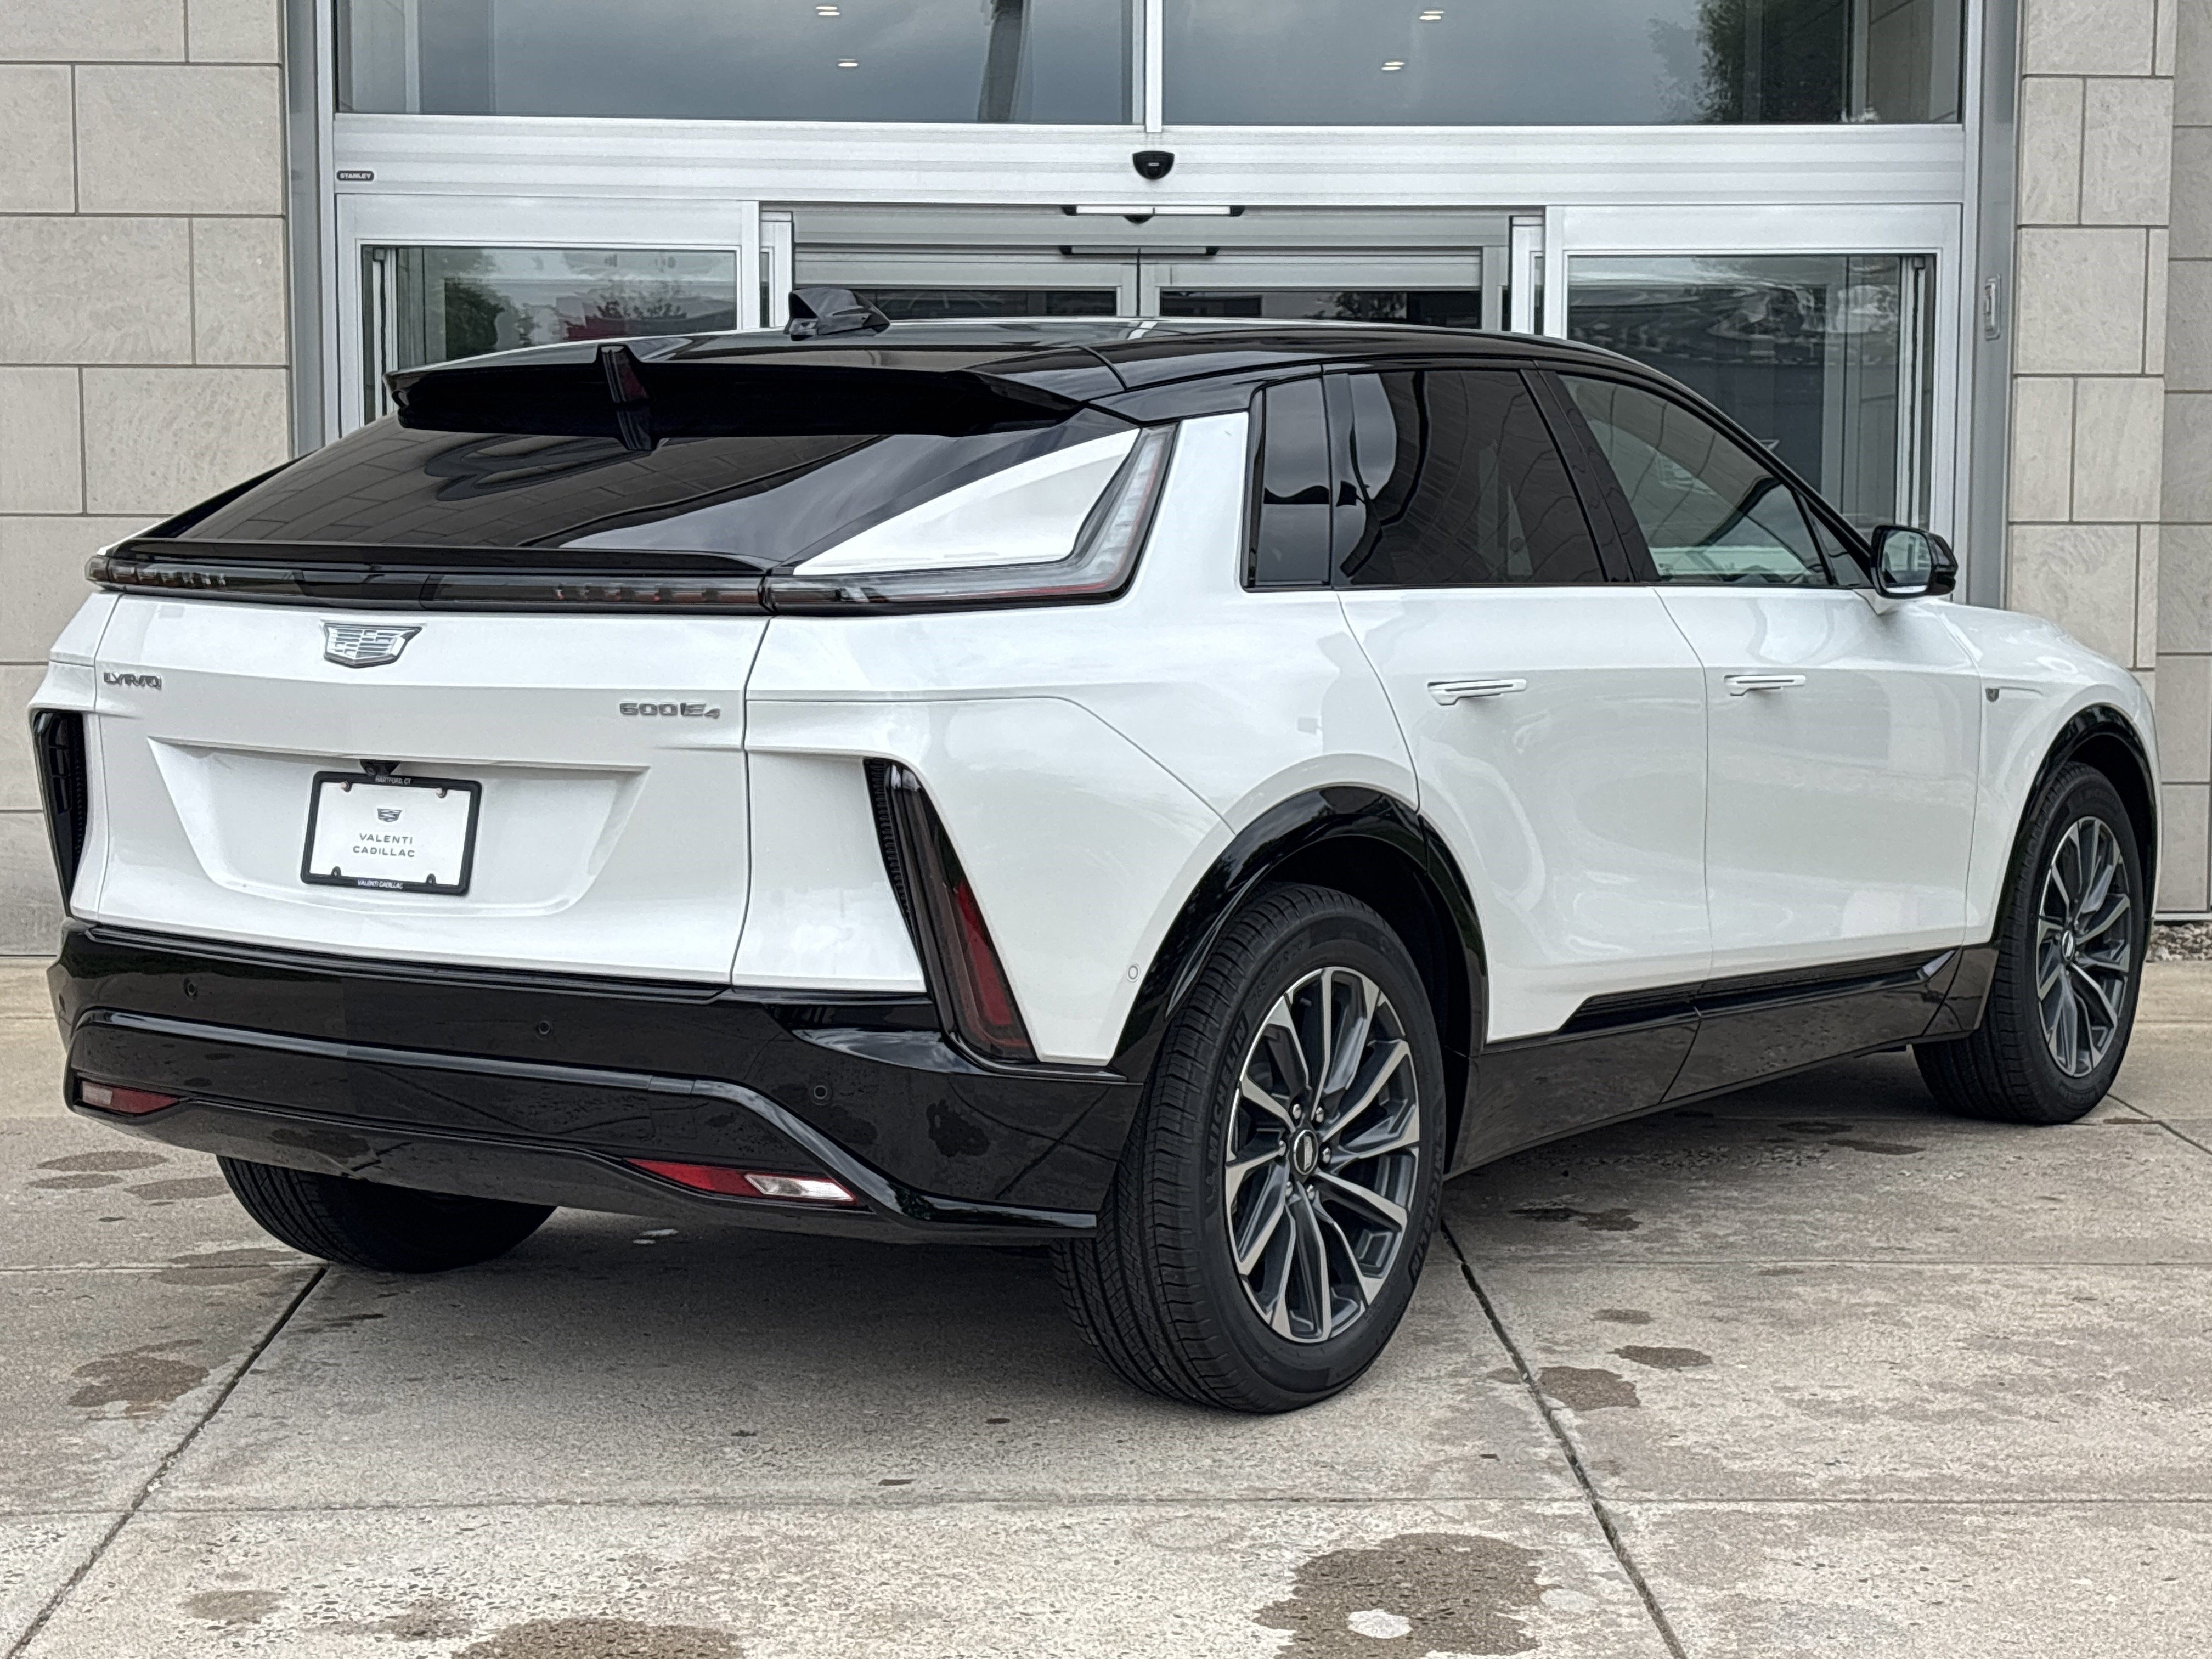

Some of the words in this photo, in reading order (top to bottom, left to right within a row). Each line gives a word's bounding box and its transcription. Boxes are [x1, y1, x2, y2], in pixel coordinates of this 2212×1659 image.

[359, 833, 413, 844] VALENTI
[353, 845, 415, 857] CADILLAC
[358, 879, 379, 887] VALENTI
[379, 881, 403, 889] CADILLAC
[1207, 1019, 1248, 1164] MICHELIN
